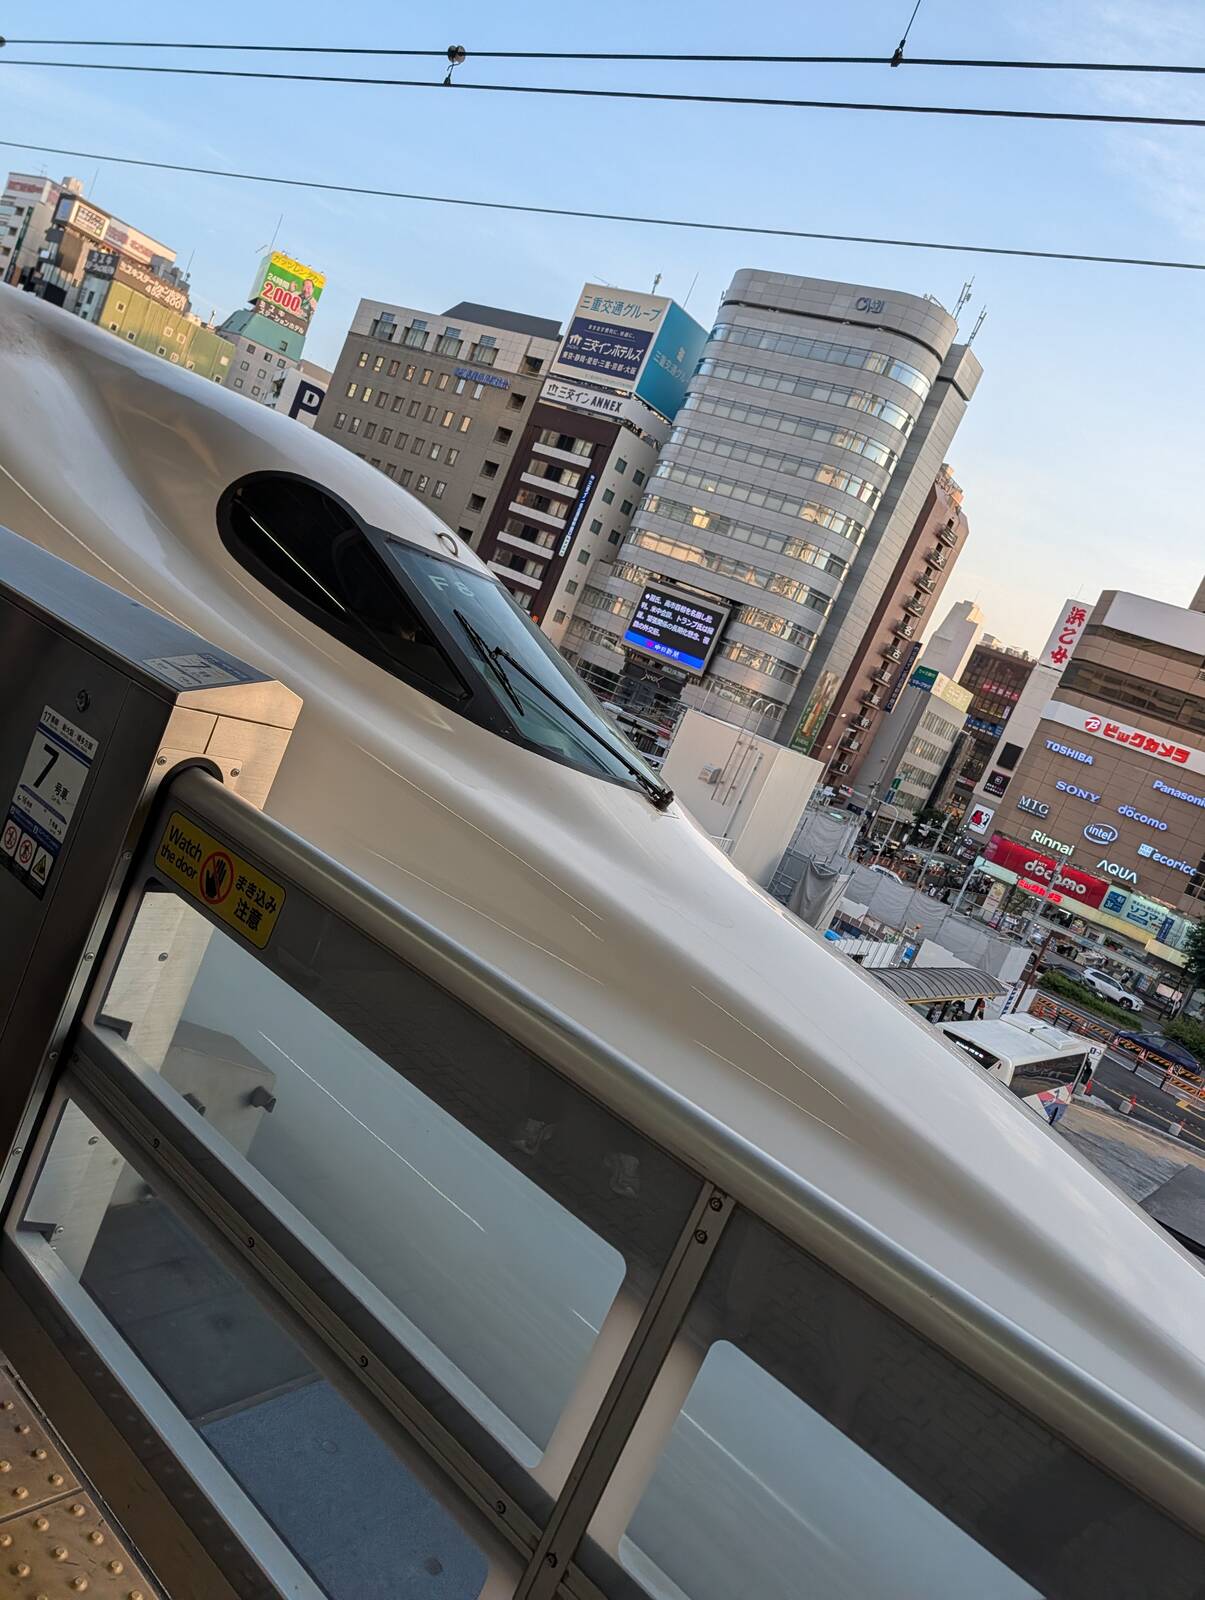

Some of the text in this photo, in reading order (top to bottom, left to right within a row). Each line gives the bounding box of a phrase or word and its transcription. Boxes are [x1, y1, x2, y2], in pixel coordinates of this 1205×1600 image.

[580, 295, 662, 321] 三重交通グループ
[258, 309, 304, 334] ステーションホテル
[581, 338, 645, 362] 三交インホテルズ
[288, 379, 326, 420] P
[559, 386, 623, 413] 三交イン ANNEX
[1051, 606, 1087, 664] 浜乙女
[654, 644, 680, 659] 中日新聞
[1046, 740, 1093, 765] TOSHIBA
[1103, 722, 1191, 764] ビックカメラ
[33, 743, 59, 788] 7
[54, 782, 70, 800] 号車
[1055, 780, 1100, 803] SONY
[1019, 795, 1049, 815] MTG
[1118, 804, 1167, 830] docomo
[169, 825, 203, 862] Watch
[1030, 829, 1075, 856] Rinnai
[1089, 824, 1113, 840] intel
[160, 844, 198, 880] the door
[1096, 859, 1137, 884] AQUA
[235, 875, 277, 914] まき込み
[233, 898, 263, 931] 注意
